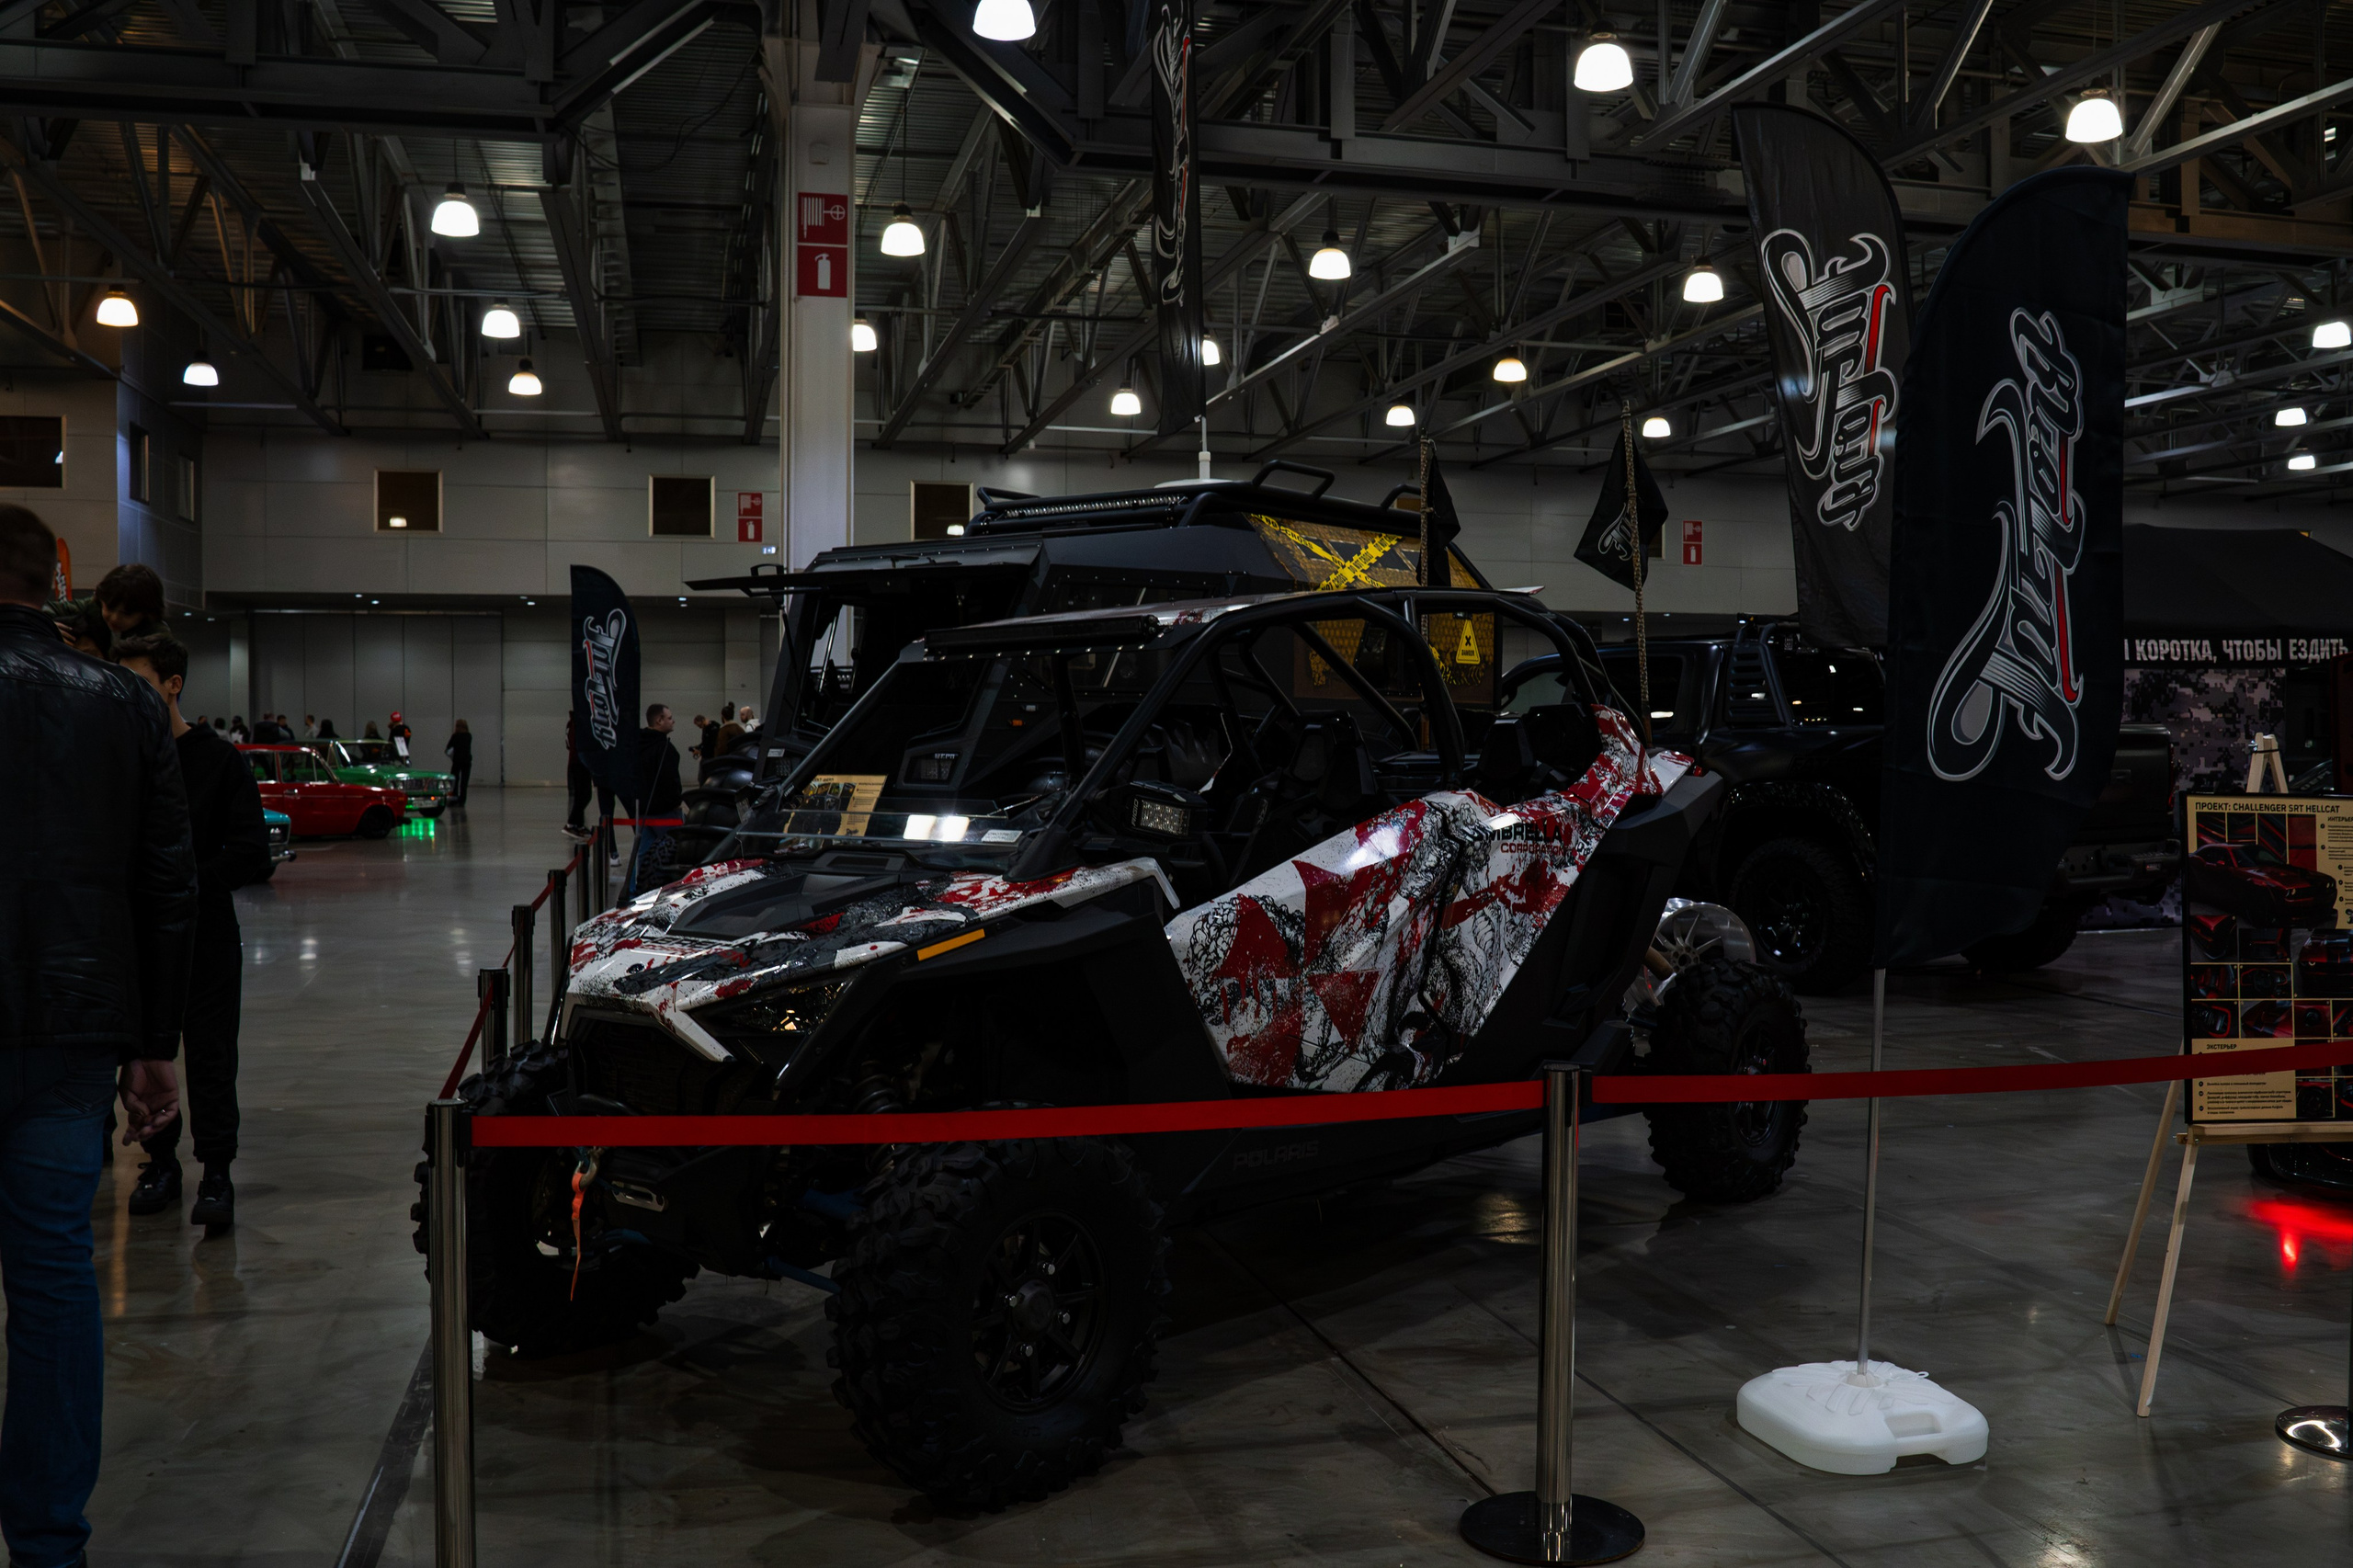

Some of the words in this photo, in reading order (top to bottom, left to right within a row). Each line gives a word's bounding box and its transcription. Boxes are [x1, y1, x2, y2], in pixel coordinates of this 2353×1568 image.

[2135, 639, 2217, 664] КОРОТКА,
[2222, 639, 2282, 661] ЧТОБЫ
[2195, 801, 2231, 811] ПРОЕКТ:
[2233, 803, 2287, 812] CHALLENGER
[2288, 804, 2303, 812] SRT
[2305, 805, 2340, 813] HELLCAT
[1233, 1140, 1321, 1170] POLARIS
